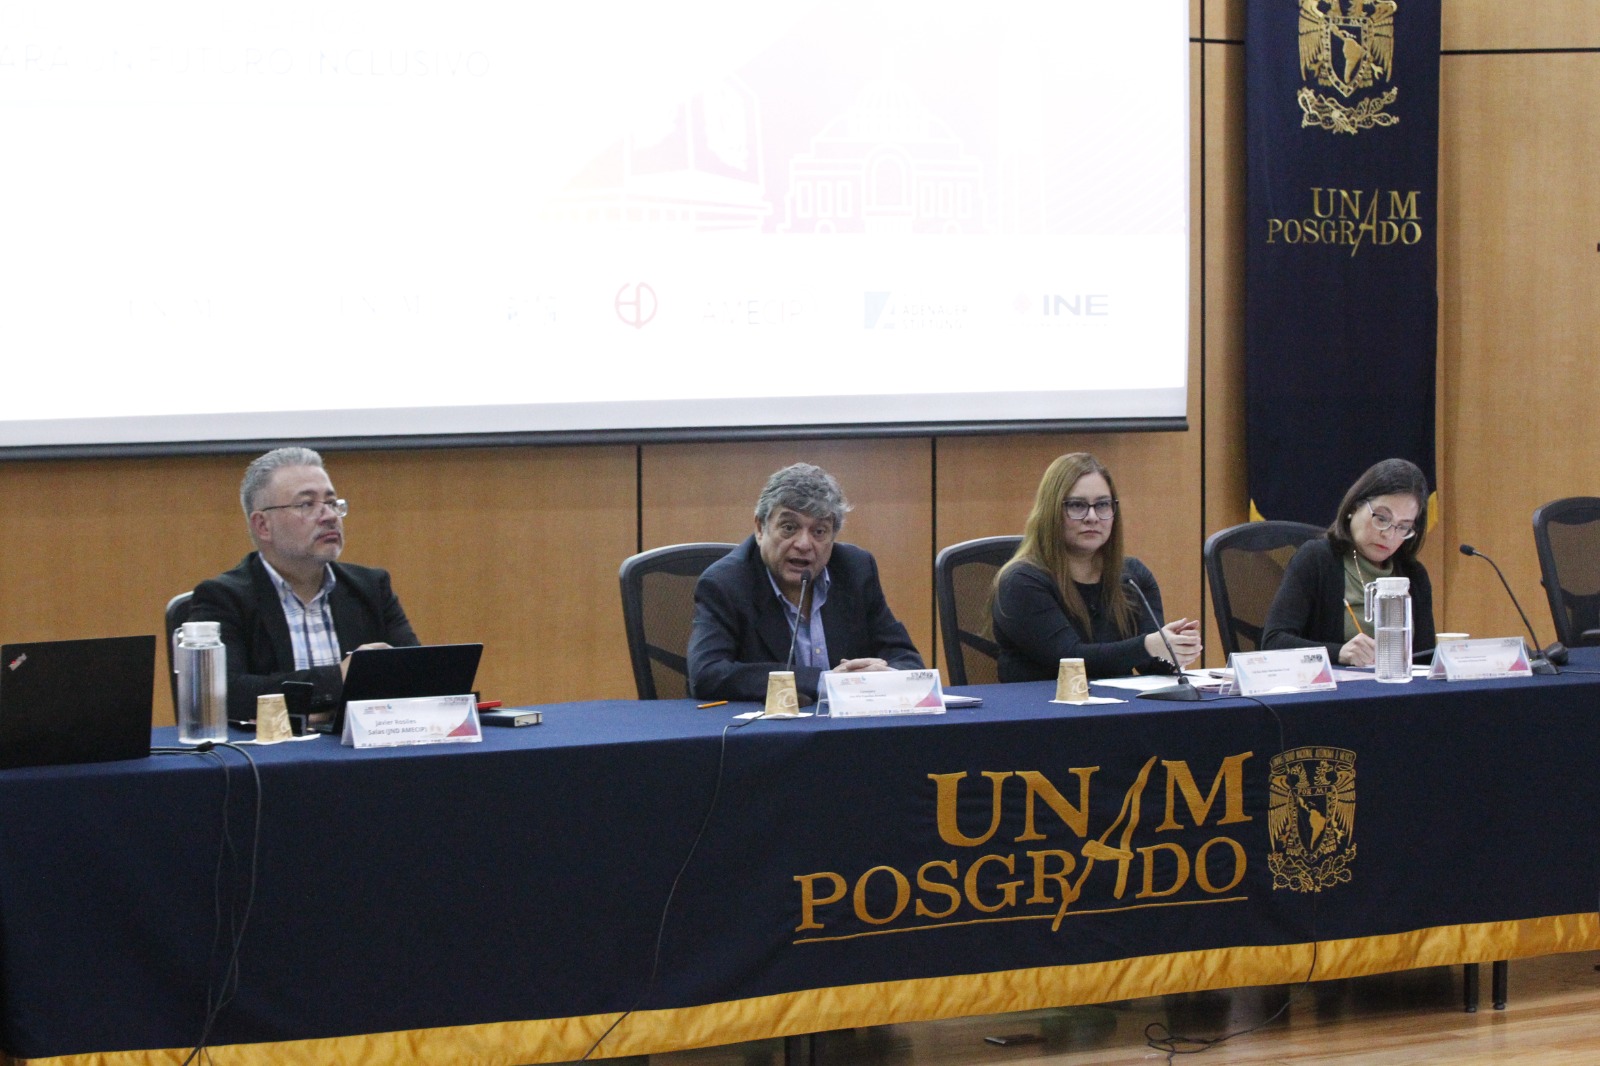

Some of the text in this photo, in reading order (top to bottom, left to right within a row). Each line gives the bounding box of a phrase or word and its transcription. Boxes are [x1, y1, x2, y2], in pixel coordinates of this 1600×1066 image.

[309, 48, 491, 77] INCLUSIVO
[1310, 187, 1422, 220] UNAM
[1266, 218, 1422, 257] POSGRADO
[1043, 294, 1109, 316] INE
[928, 751, 1253, 847] UNAM
[793, 836, 1247, 932] POSGRADO
